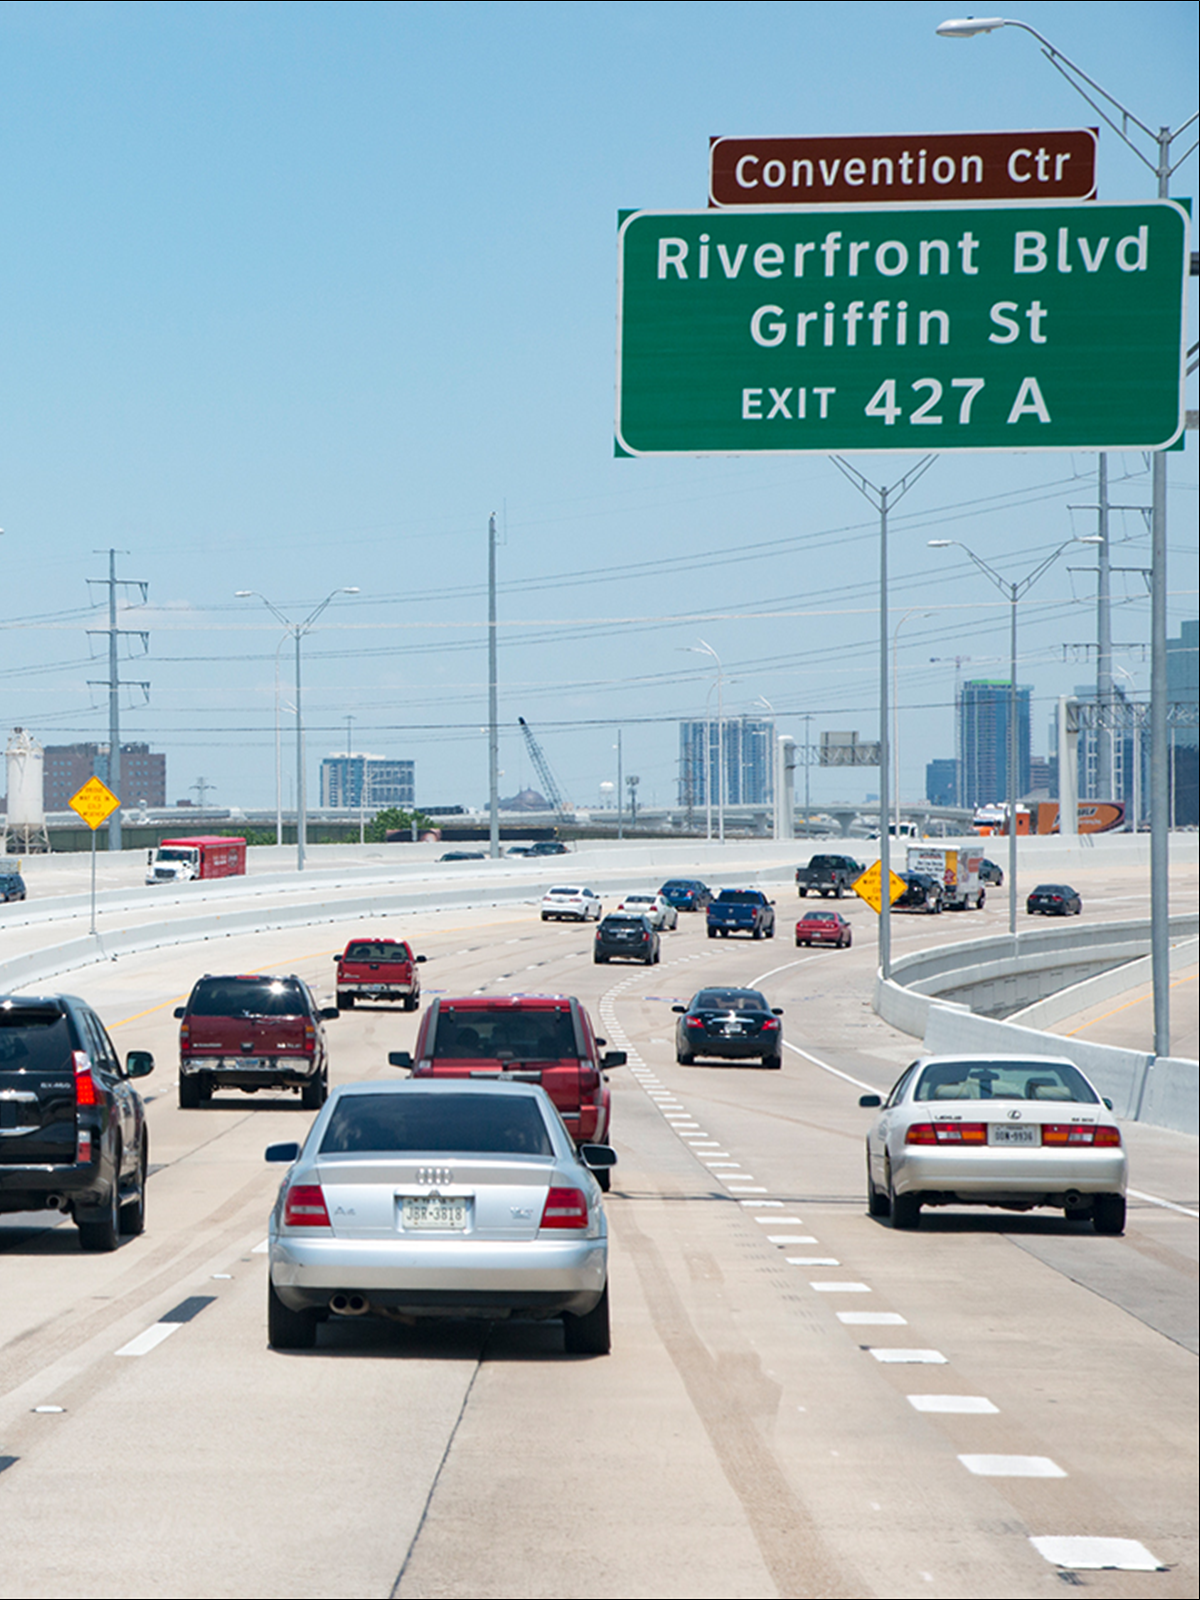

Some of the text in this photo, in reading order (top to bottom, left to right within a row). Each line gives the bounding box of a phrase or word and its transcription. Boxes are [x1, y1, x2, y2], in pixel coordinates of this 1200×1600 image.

[735, 148, 1071, 188] Convention Ctr
[657, 225, 1149, 279] Riverfront Blvd
[750, 300, 1048, 347] Griffin St
[742, 377, 1051, 425] EXIT 427 A
